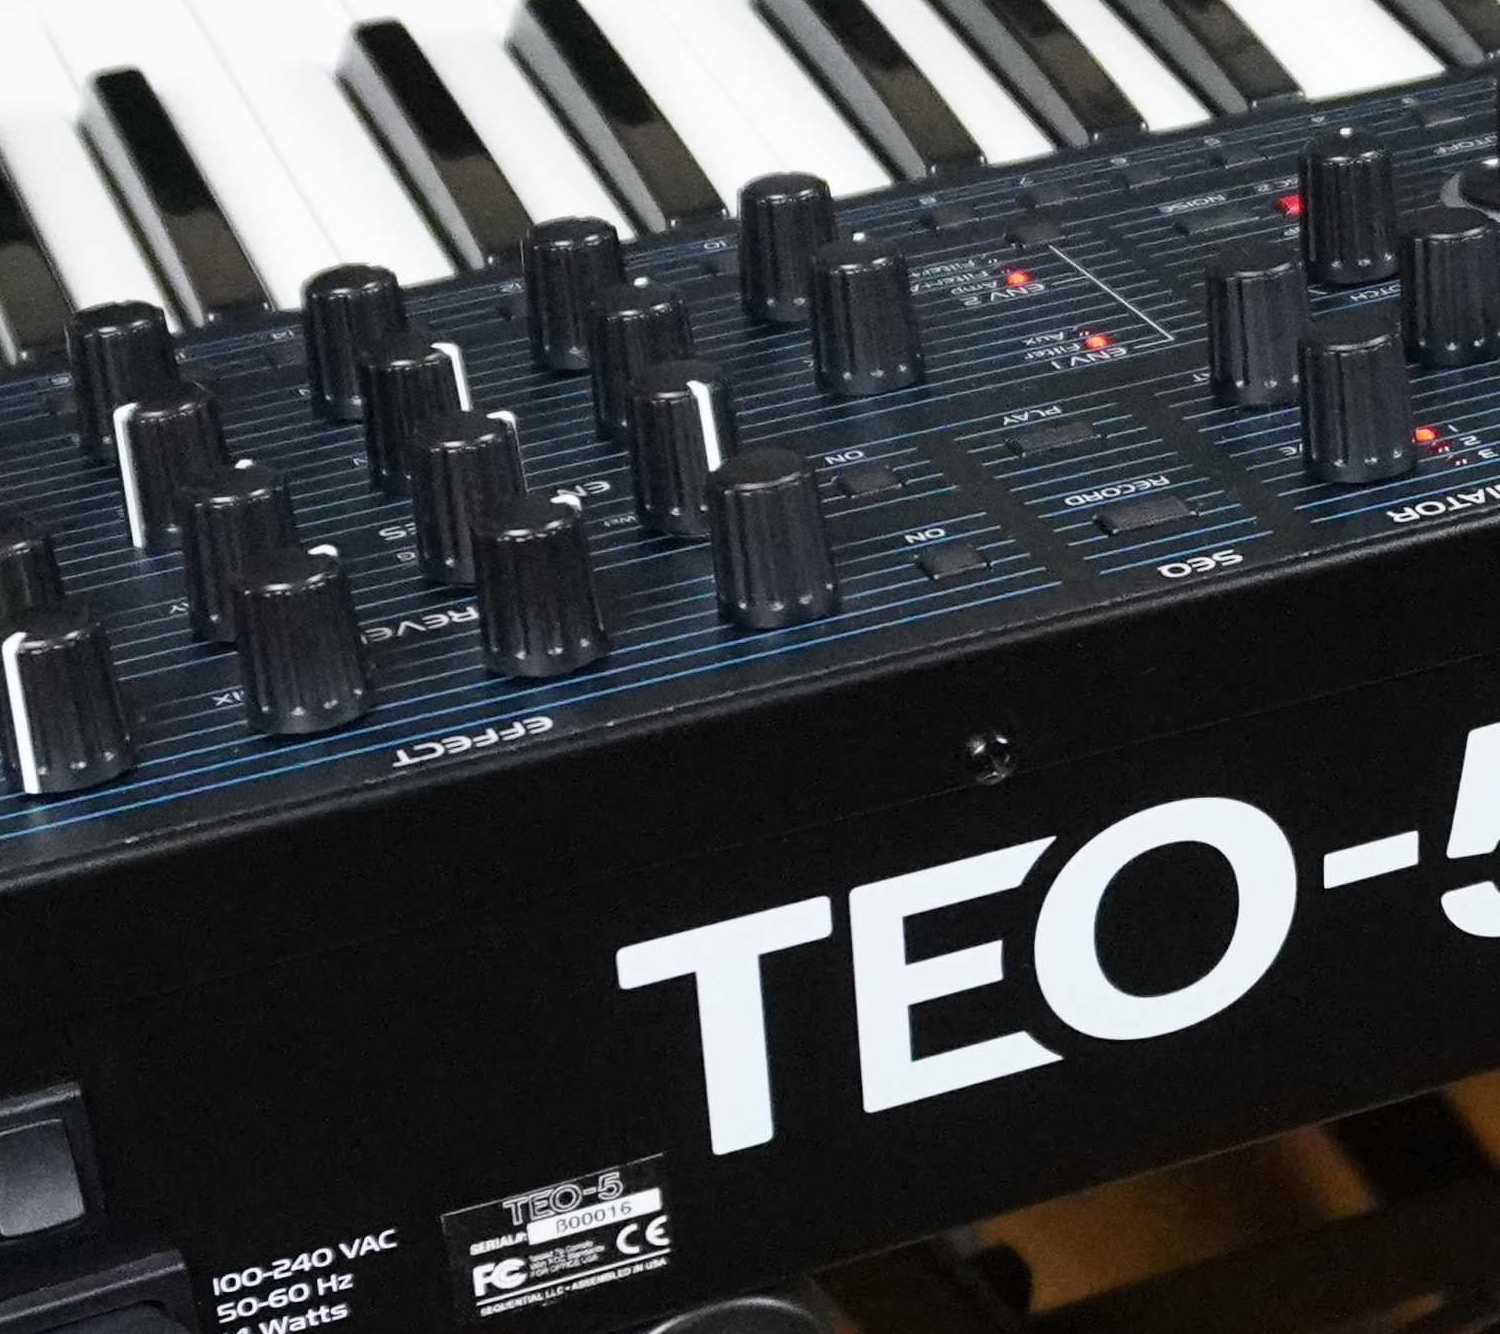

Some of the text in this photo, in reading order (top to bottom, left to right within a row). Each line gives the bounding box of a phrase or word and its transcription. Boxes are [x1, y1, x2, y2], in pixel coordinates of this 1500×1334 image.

[1435, 134, 1498, 156] UTOFF
[1158, 193, 1227, 215] NOISE
[950, 290, 998, 306] Amp
[1349, 283, 1401, 302] OTCH
[959, 293, 1045, 317] ENV 2
[1021, 330, 1064, 347] Aux
[1023, 342, 1081, 361] Filter
[1070, 346, 1128, 368] ENV
[1001, 404, 1064, 427] PLAY
[1460, 434, 1477, 446] 2
[823, 448, 866, 466] ON
[1478, 448, 1498, 459] 3
[1064, 474, 1171, 506] RECORD
[904, 526, 947, 545] ON
[1156, 548, 1244, 579] SEQ
[361, 605, 478, 645] REVE
[212, 690, 246, 706] IX
[393, 714, 555, 768] EFFECT
[502, 1170, 624, 1227] TEO-5
[554, 1200, 633, 1235] B00016
[212, 1227, 399, 1297] 100-240 VAC
[216, 1272, 355, 1324] 50-60 Hz
